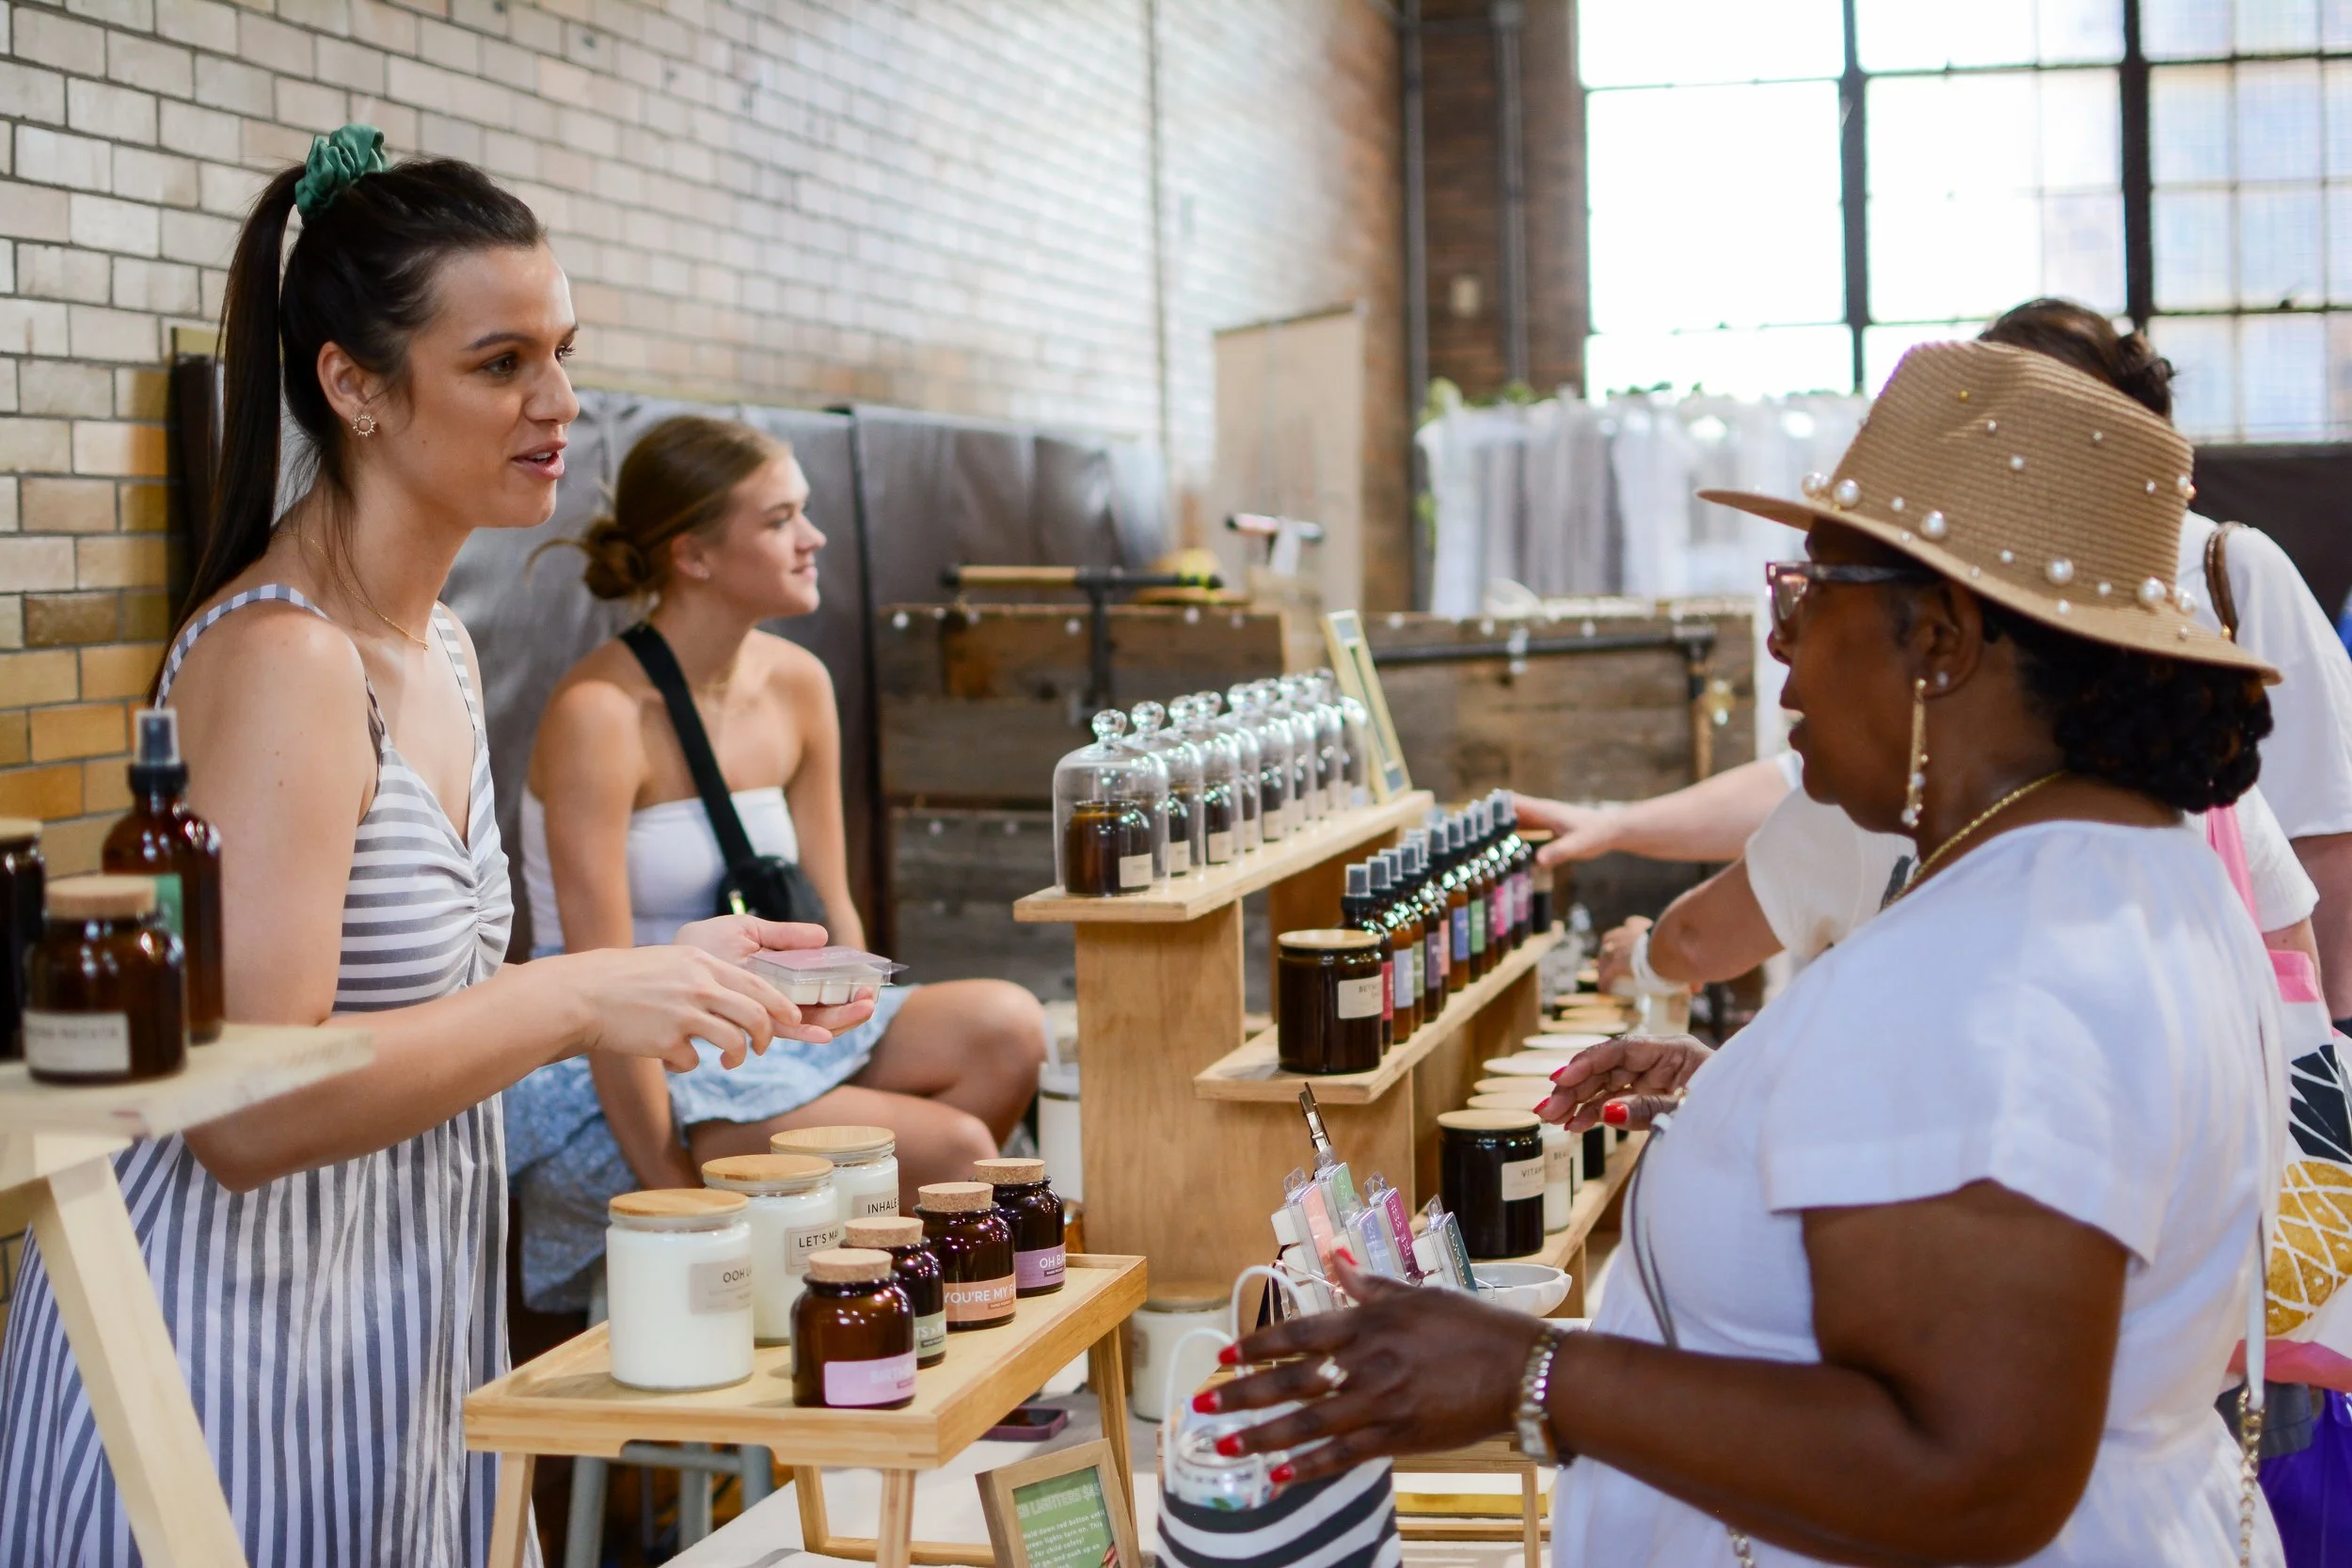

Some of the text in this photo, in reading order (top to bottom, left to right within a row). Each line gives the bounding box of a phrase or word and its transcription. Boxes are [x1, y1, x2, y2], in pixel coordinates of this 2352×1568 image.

[867, 1196, 898, 1214] INHALE
[799, 1233, 827, 1248] LET'S
[1039, 1256, 1055, 1269] OH
[723, 1268, 745, 1283] OOH
[944, 1290, 991, 1304] YOU'RE
[993, 1286, 1007, 1300] MY
[1069, 1515, 1089, 1527] button
